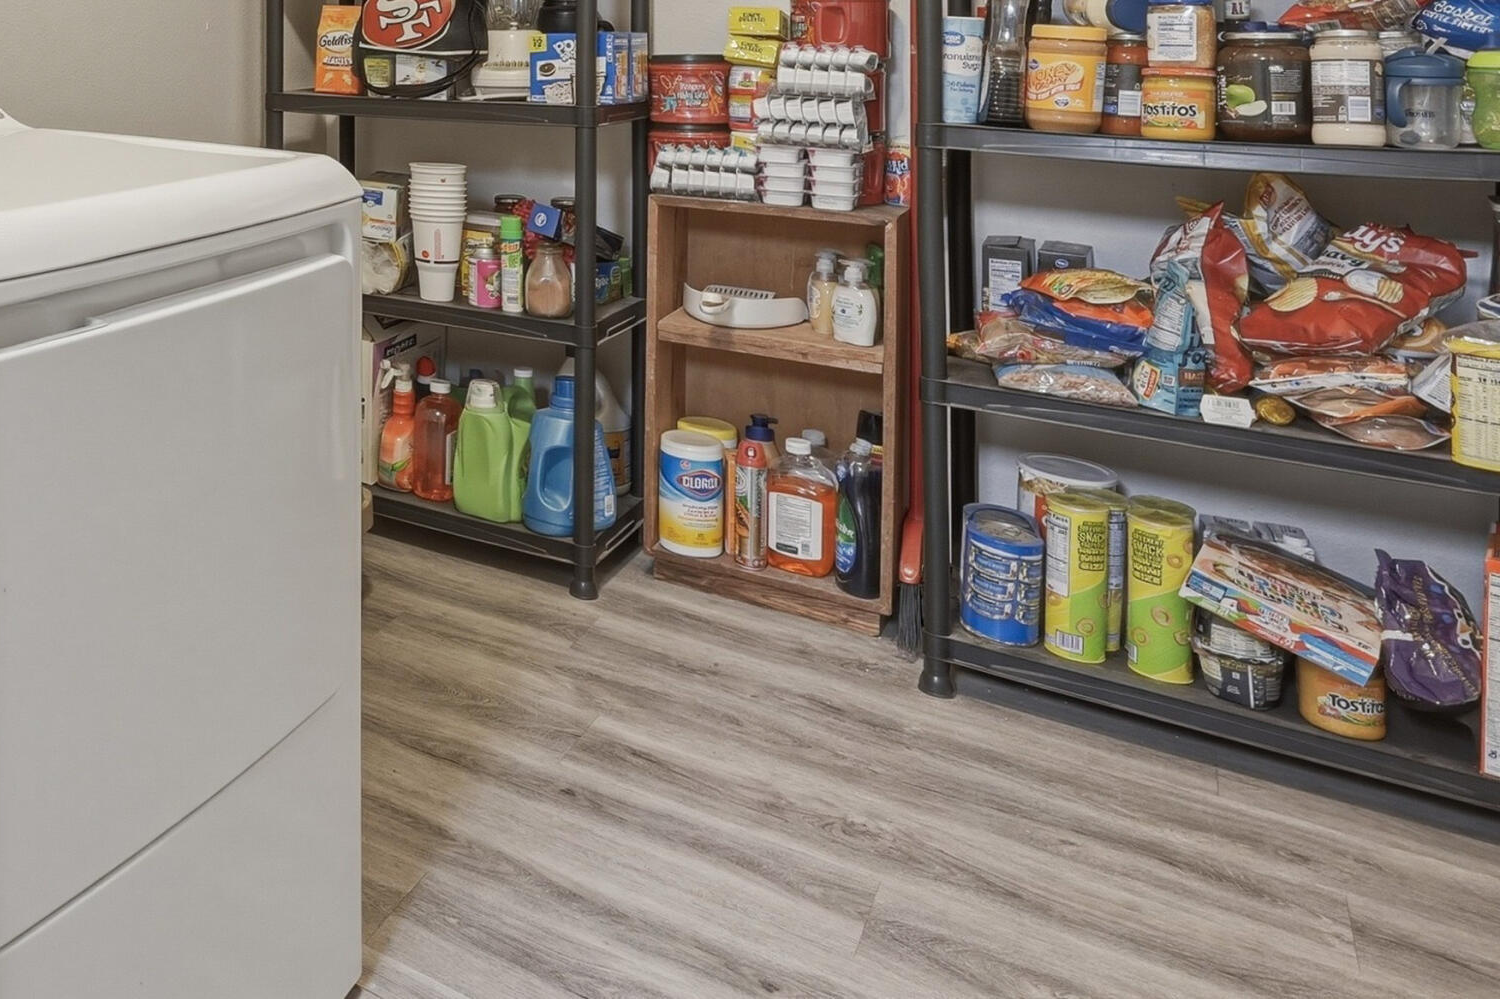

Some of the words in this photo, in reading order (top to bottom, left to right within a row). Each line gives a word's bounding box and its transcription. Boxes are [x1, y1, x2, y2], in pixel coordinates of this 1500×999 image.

[319, 33, 354, 47] Goldfis
[943, 53, 981, 61] ranulat
[962, 61, 980, 71] Sug
[1328, 693, 1384, 714] TOSTITO
